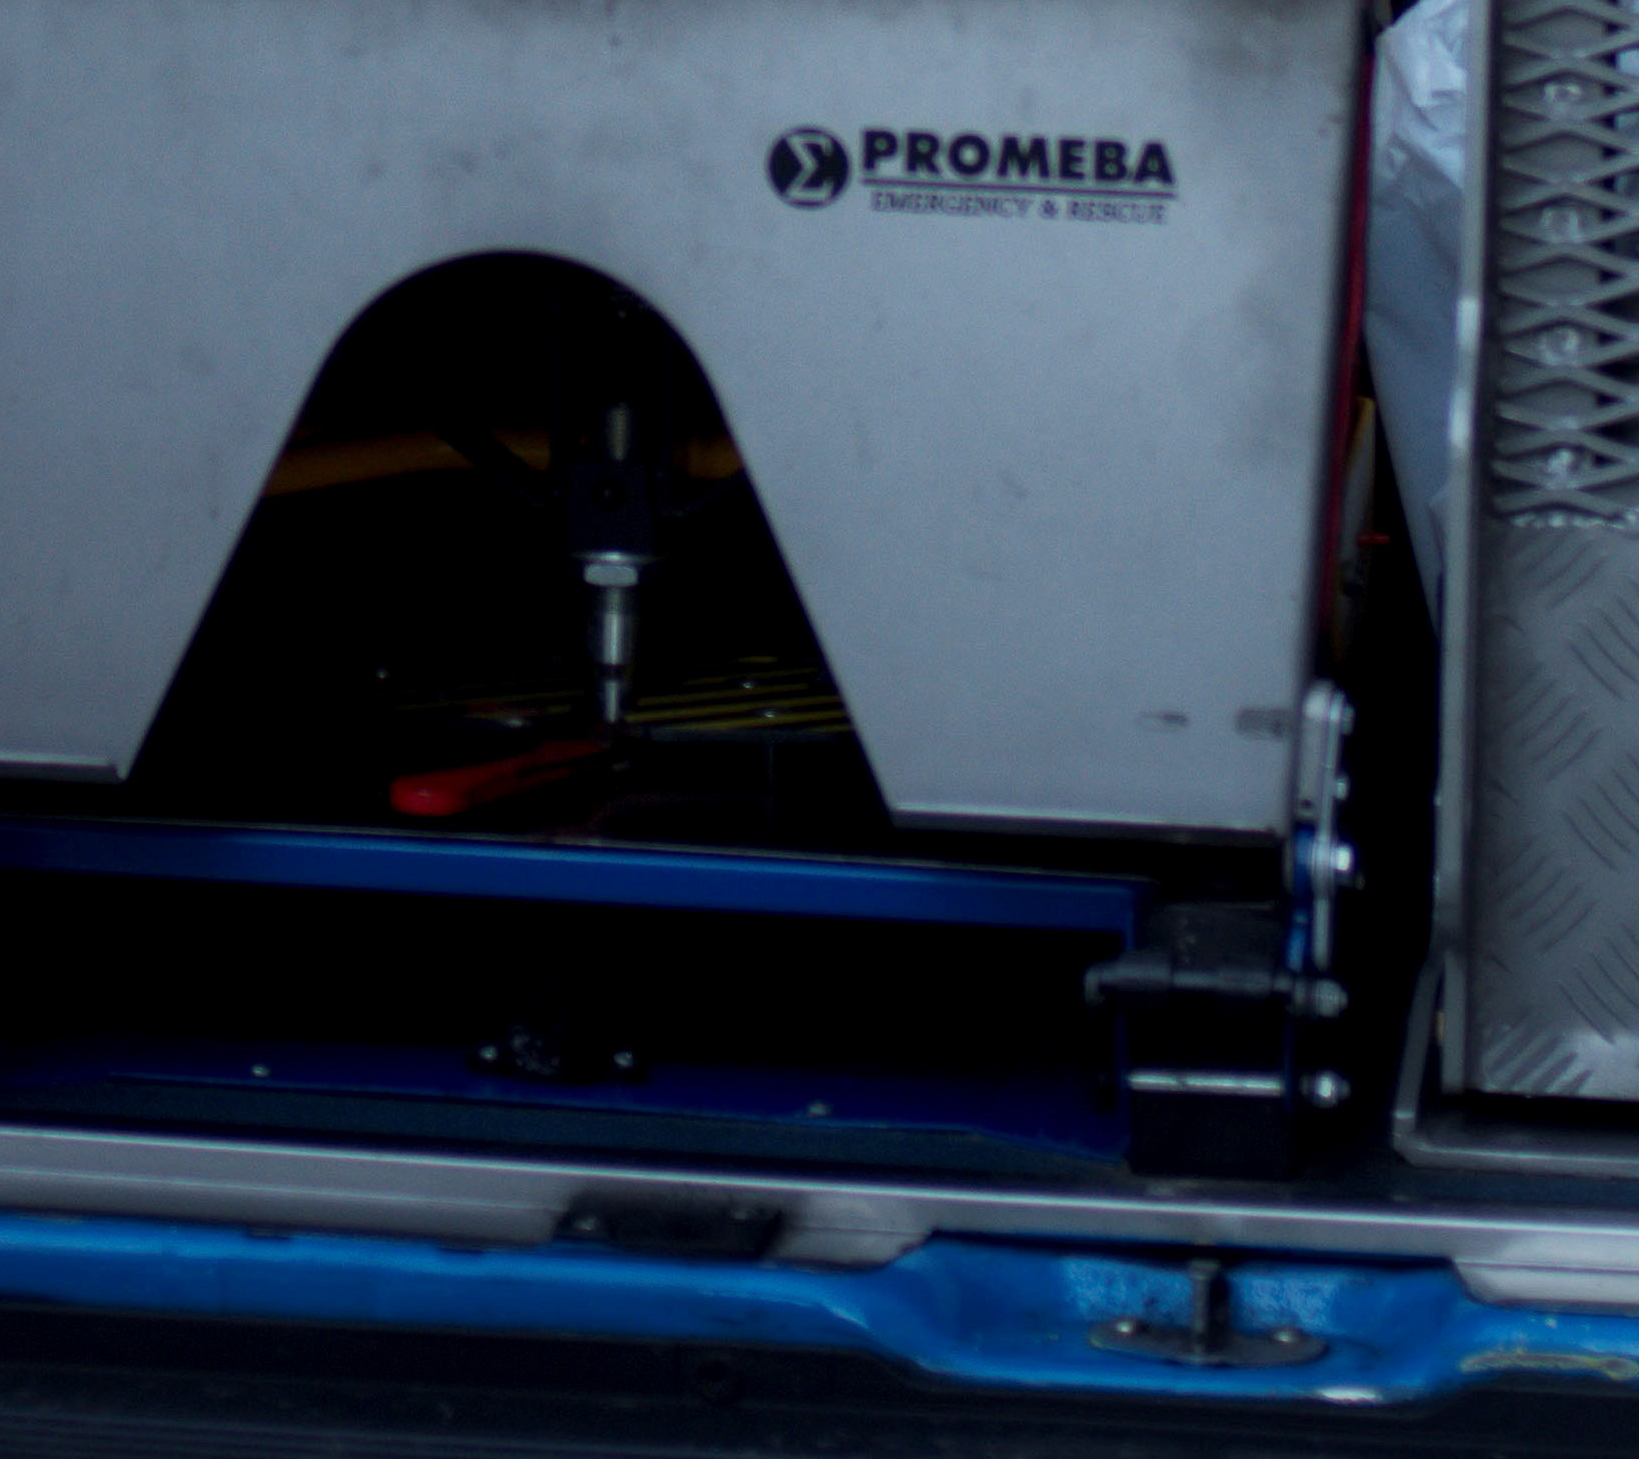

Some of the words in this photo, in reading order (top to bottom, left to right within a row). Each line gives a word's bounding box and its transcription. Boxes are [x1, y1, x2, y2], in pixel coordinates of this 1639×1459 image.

[862, 129, 1176, 186] PROMEBA
[872, 190, 1032, 220] EMERGENCY
[1038, 196, 1058, 220] &
[1066, 200, 1168, 225] RESCUE
